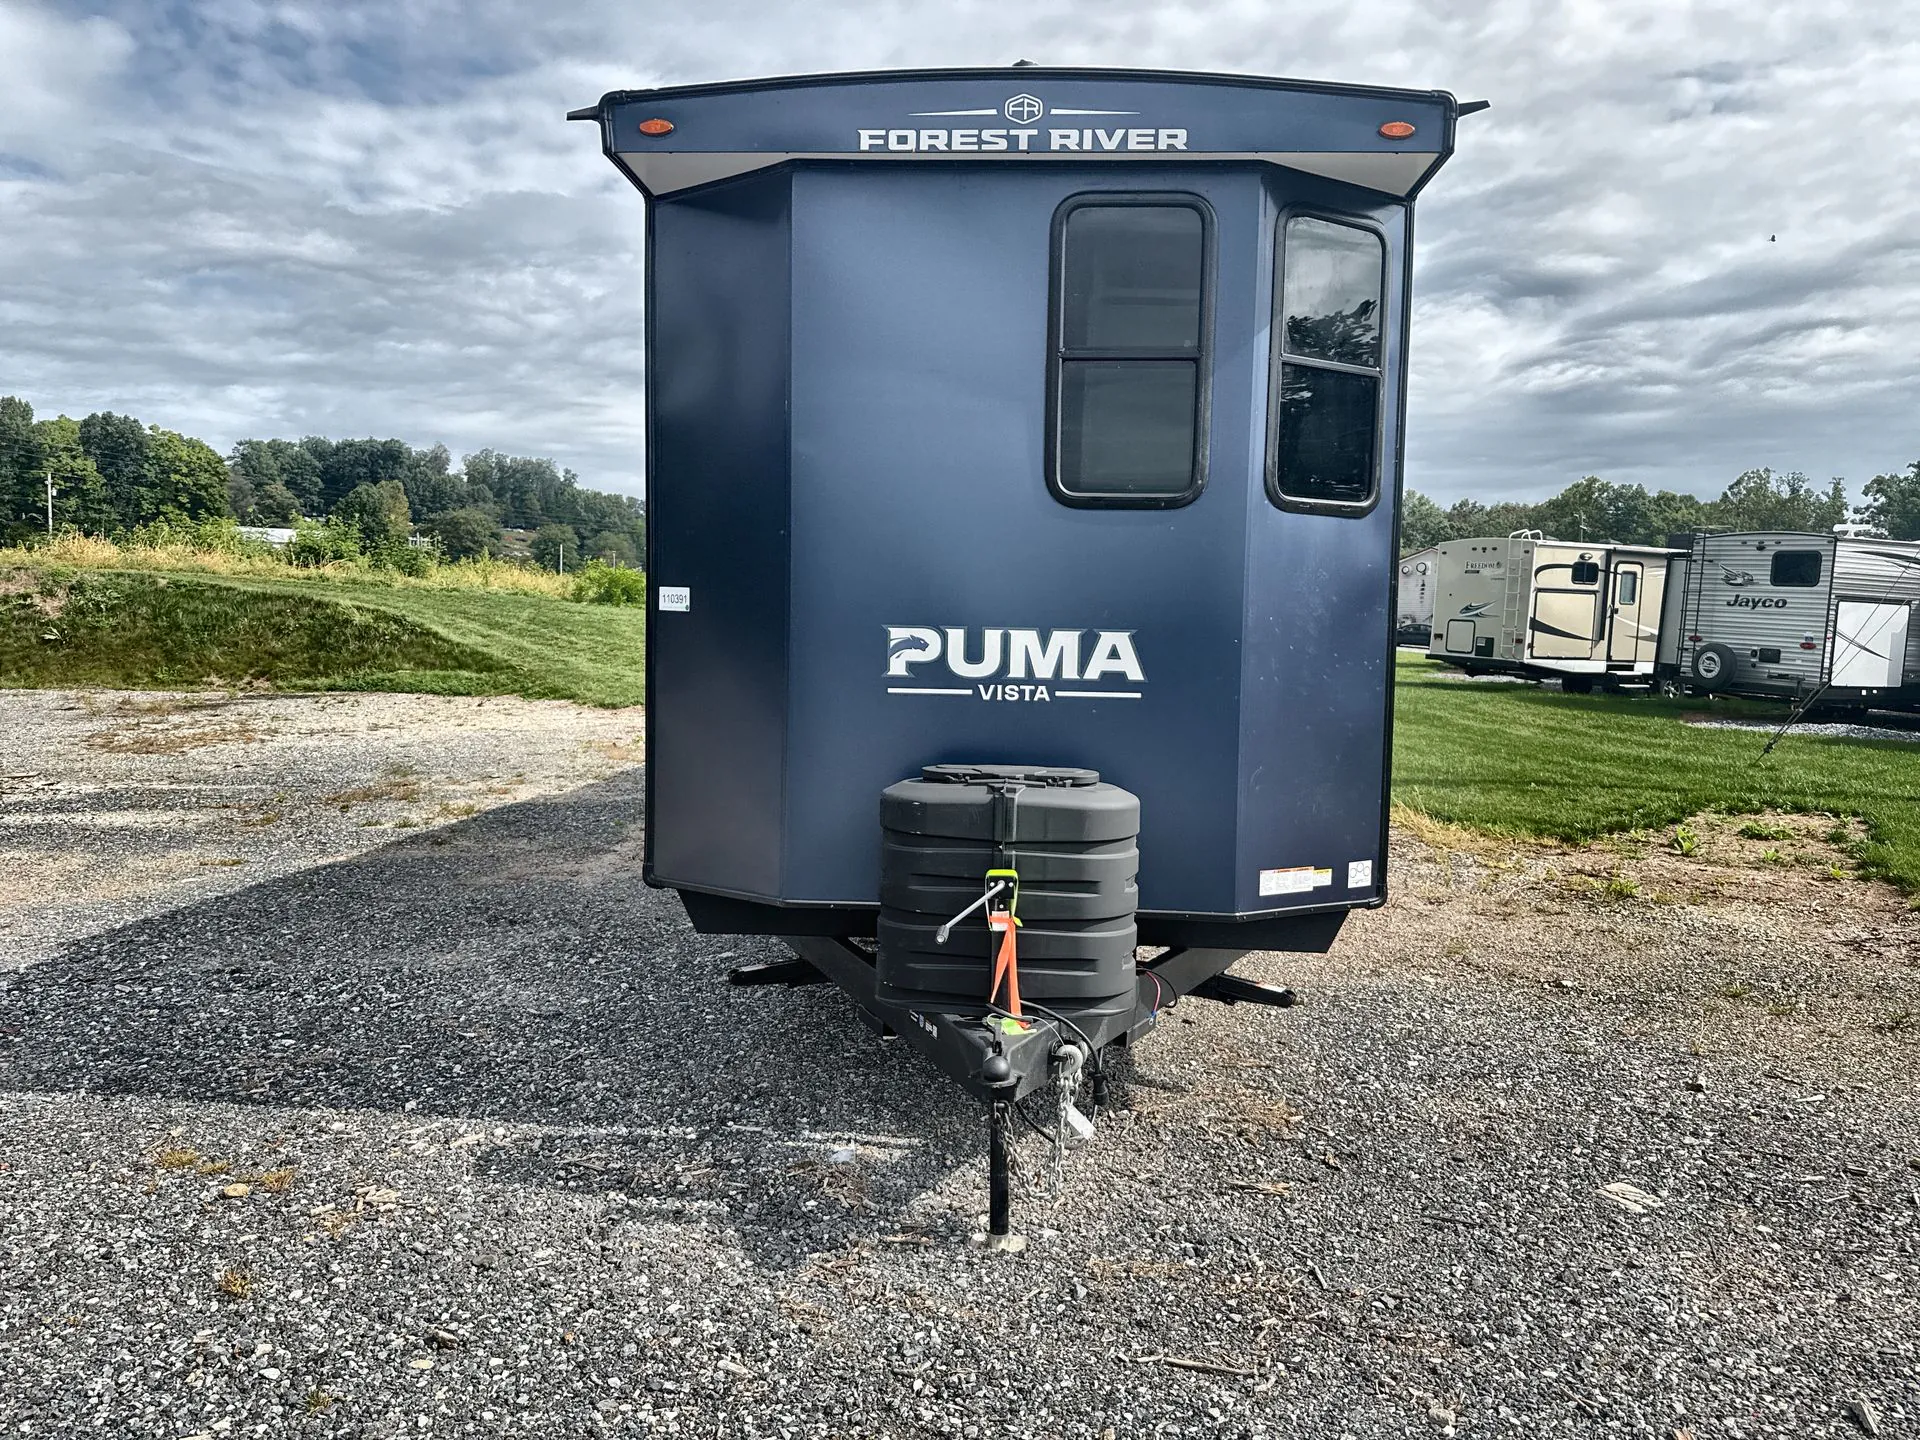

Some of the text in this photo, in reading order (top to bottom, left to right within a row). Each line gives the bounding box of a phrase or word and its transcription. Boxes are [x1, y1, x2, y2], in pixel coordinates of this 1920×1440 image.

[857, 128, 1188, 151] FOREST RIVER
[662, 593, 687, 604] 110391
[1726, 594, 1788, 610] Jayco
[884, 625, 1146, 682] PUMA
[978, 684, 1051, 701] VISTA
